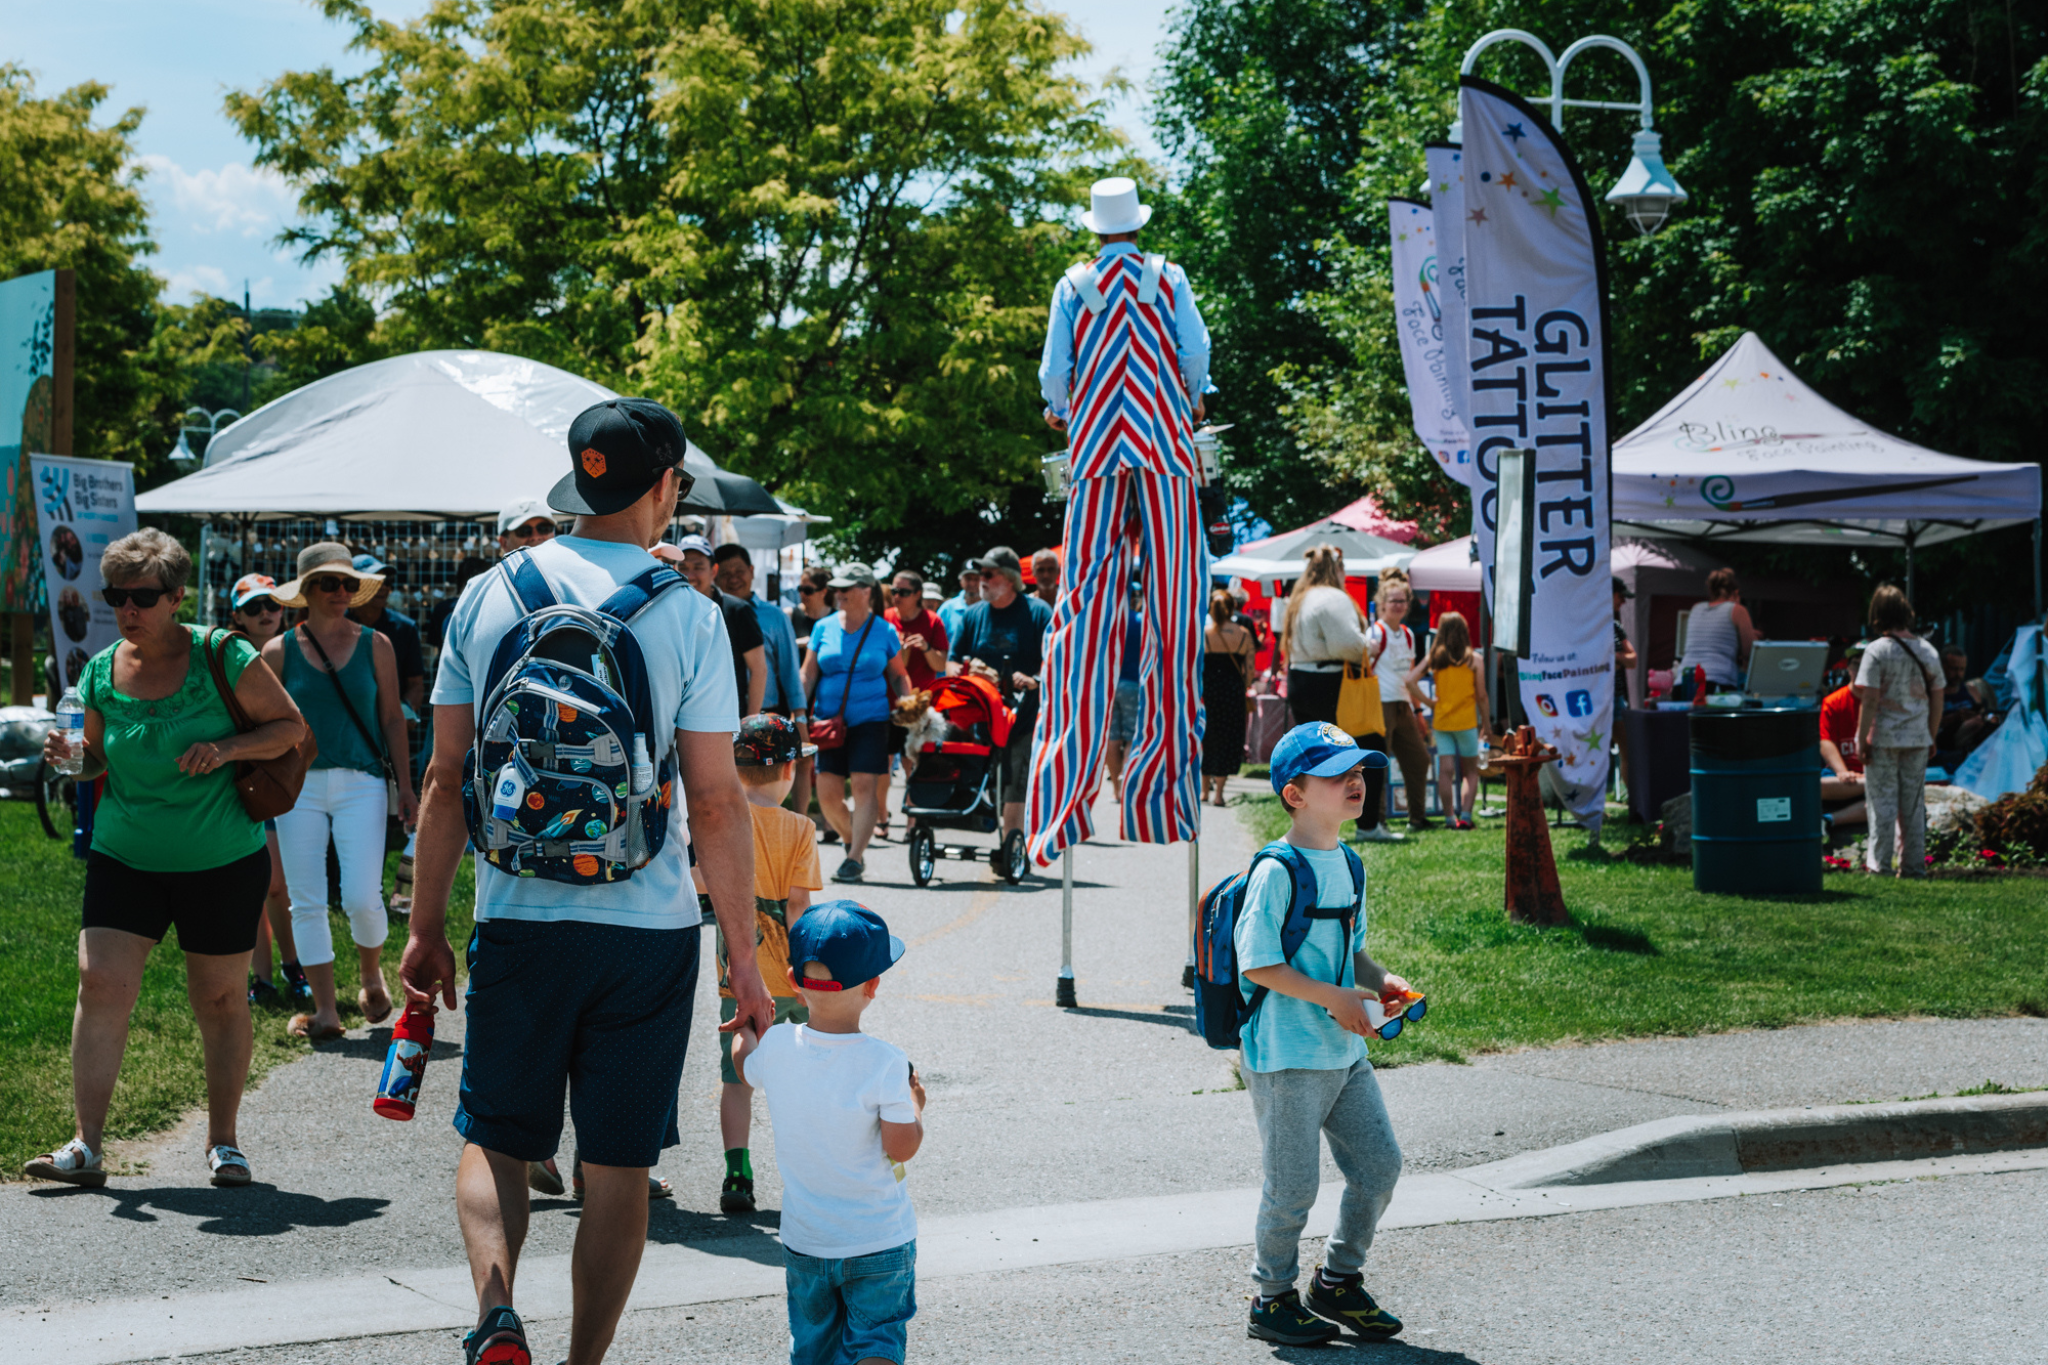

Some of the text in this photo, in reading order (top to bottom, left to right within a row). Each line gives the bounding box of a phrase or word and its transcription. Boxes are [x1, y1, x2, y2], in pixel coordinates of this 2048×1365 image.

[1471, 295, 1535, 595] TATTO
[1534, 310, 1595, 579] GLITTER
[1679, 420, 1784, 447] Bling
[73, 473, 89, 492] Big
[75, 491, 90, 510] Big
